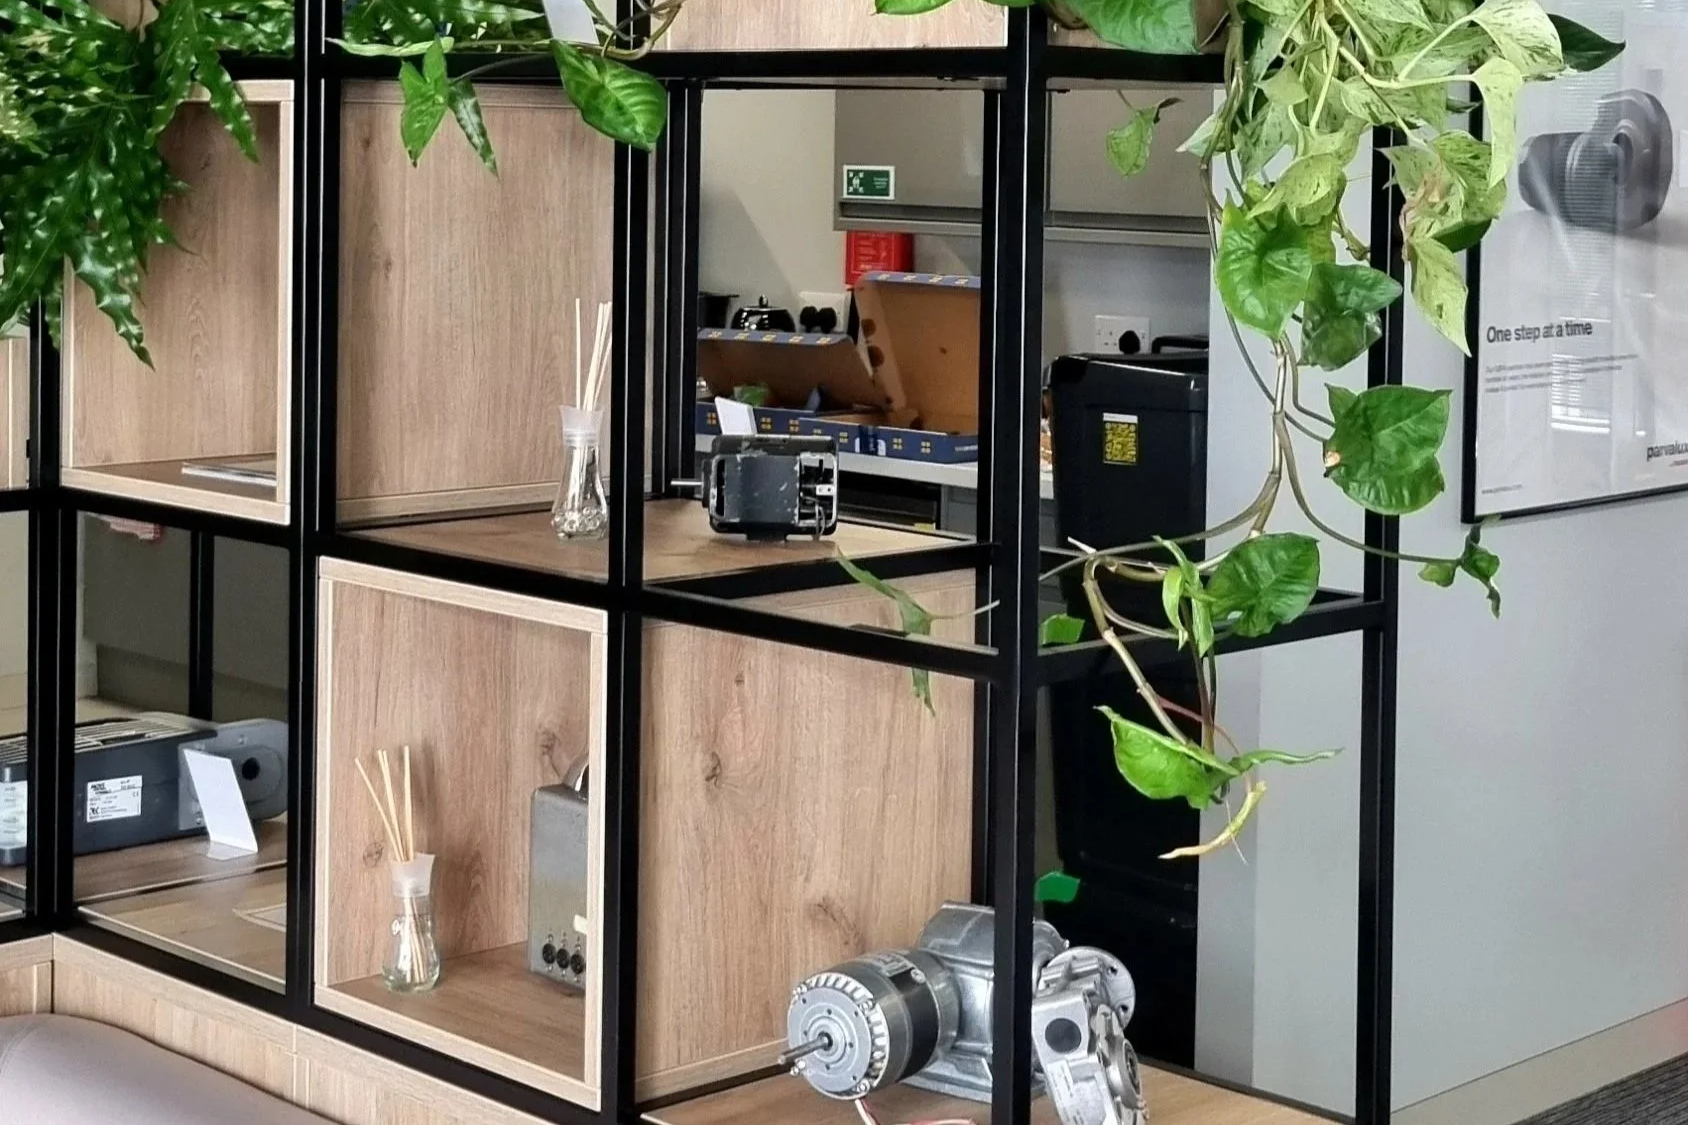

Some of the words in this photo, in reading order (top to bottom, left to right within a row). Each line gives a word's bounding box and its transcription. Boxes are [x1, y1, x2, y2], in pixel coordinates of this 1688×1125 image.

[1486, 326, 1512, 343] One
[1514, 324, 1540, 343] step
[1542, 323, 1554, 338] at
[1556, 324, 1564, 338] a
[1565, 321, 1593, 337] time
